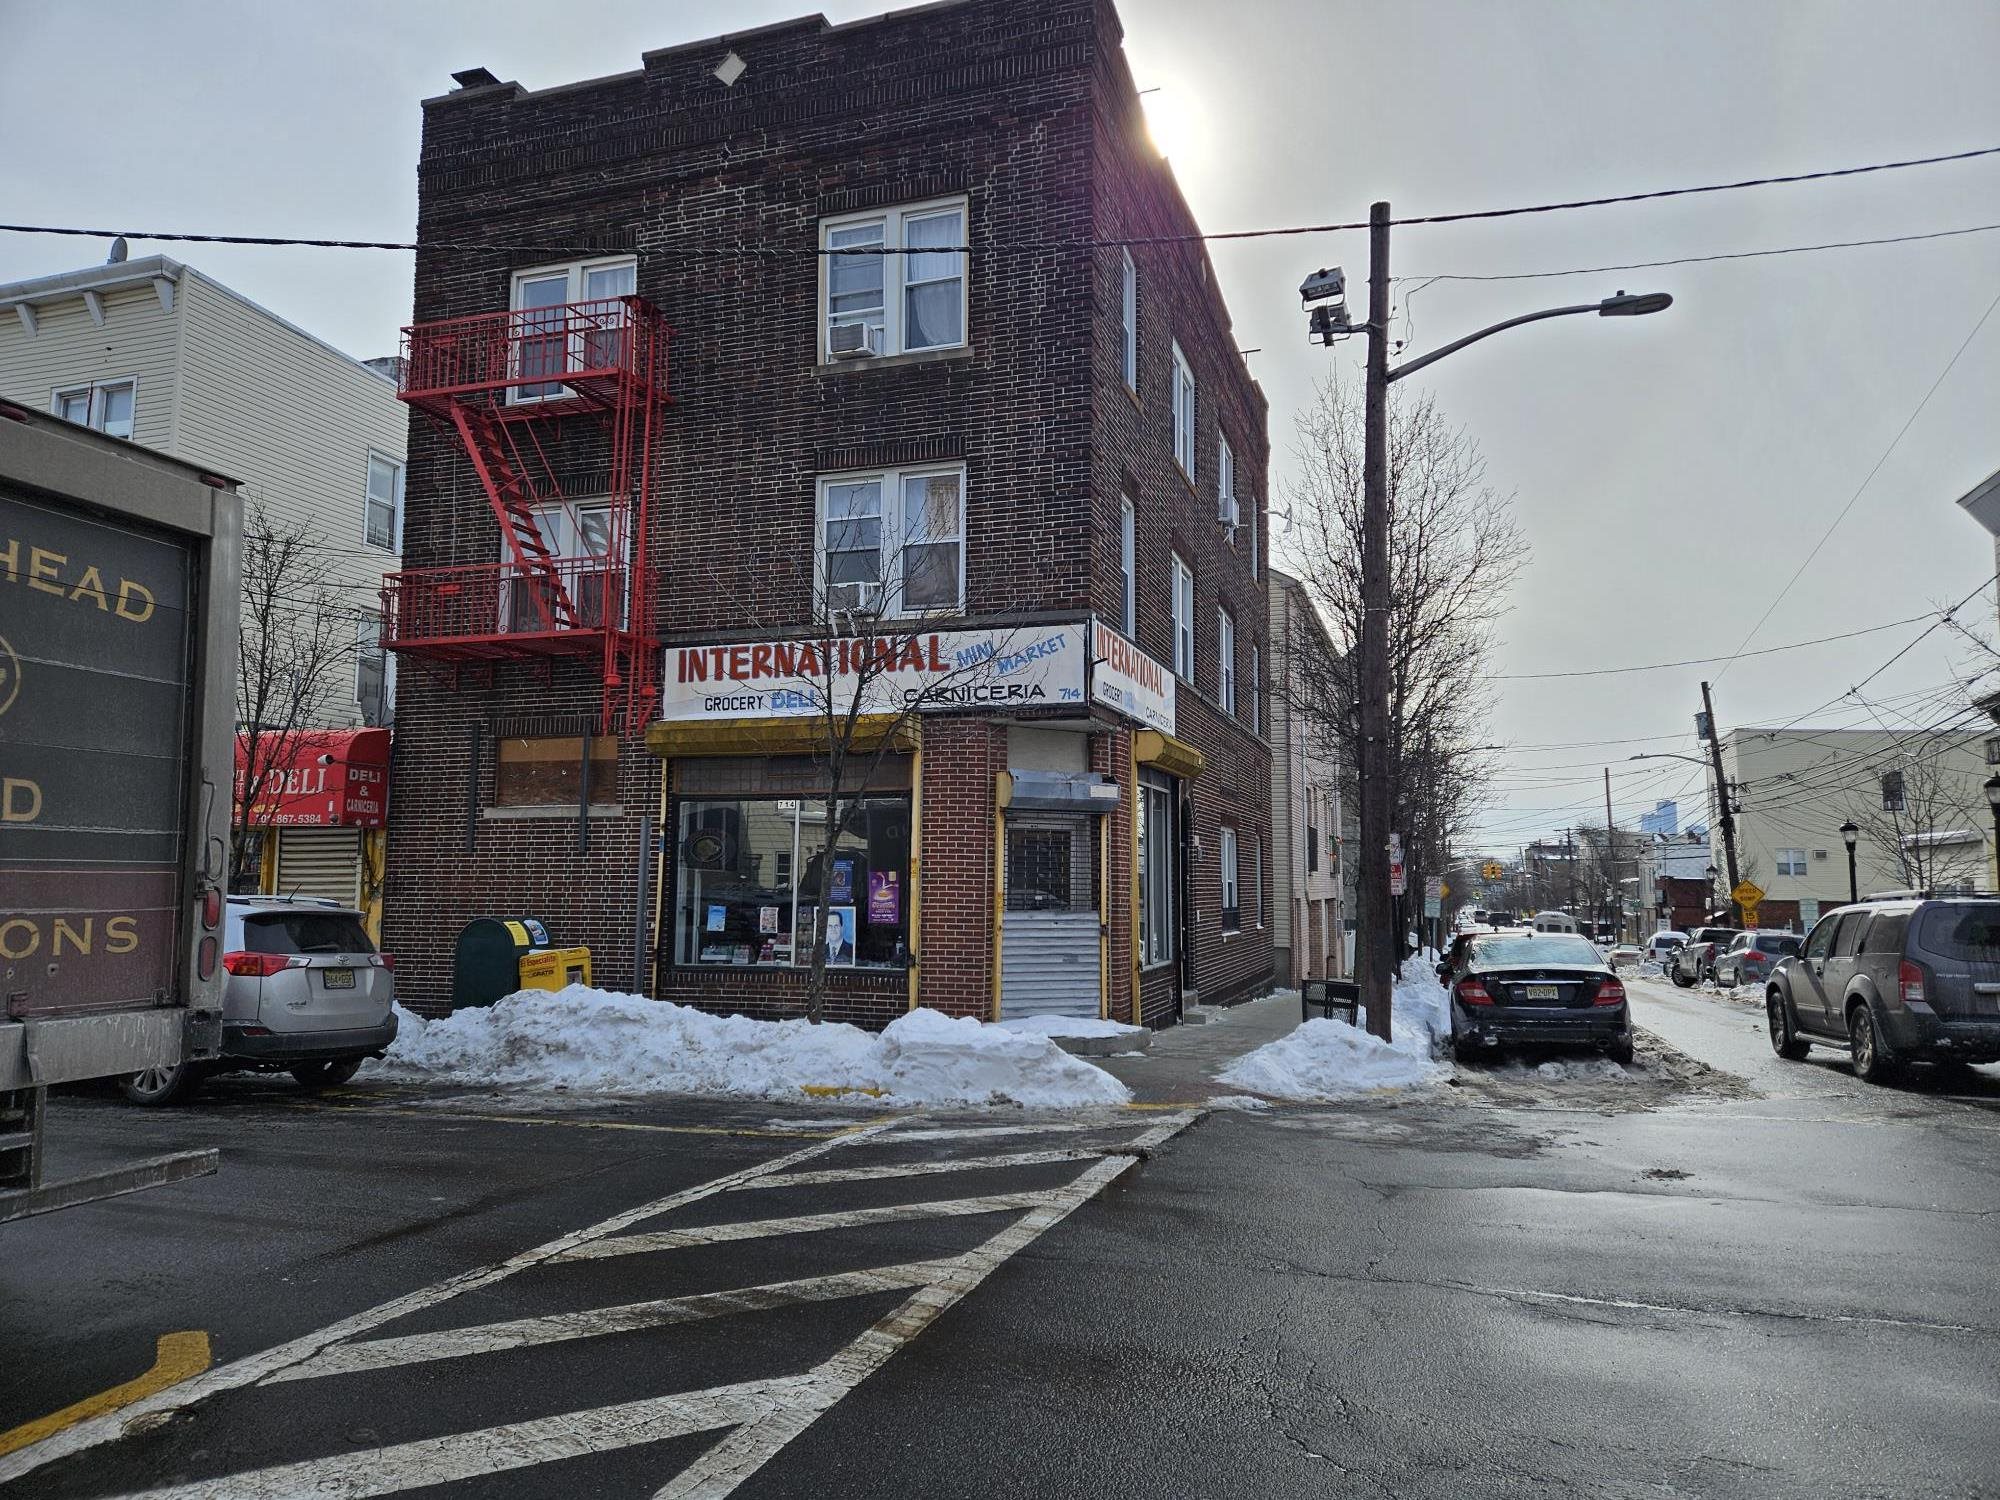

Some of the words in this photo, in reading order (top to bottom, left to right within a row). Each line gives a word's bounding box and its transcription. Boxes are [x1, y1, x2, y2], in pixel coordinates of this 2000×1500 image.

[678, 634, 950, 683] INTERNATIONAL
[956, 640, 994, 668] MINI
[997, 633, 1067, 675] MARKET
[1096, 623, 1165, 698] INTERNATIONAL
[704, 695, 764, 712] GROCERY
[771, 689, 816, 709] DELI
[904, 684, 1046, 704] CARNICERIA
[1049, 688, 1081, 700] 714
[267, 768, 327, 795] DELI
[349, 769, 381, 783] DELI
[360, 785, 369, 796] &
[1746, 912, 1755, 920] 15
